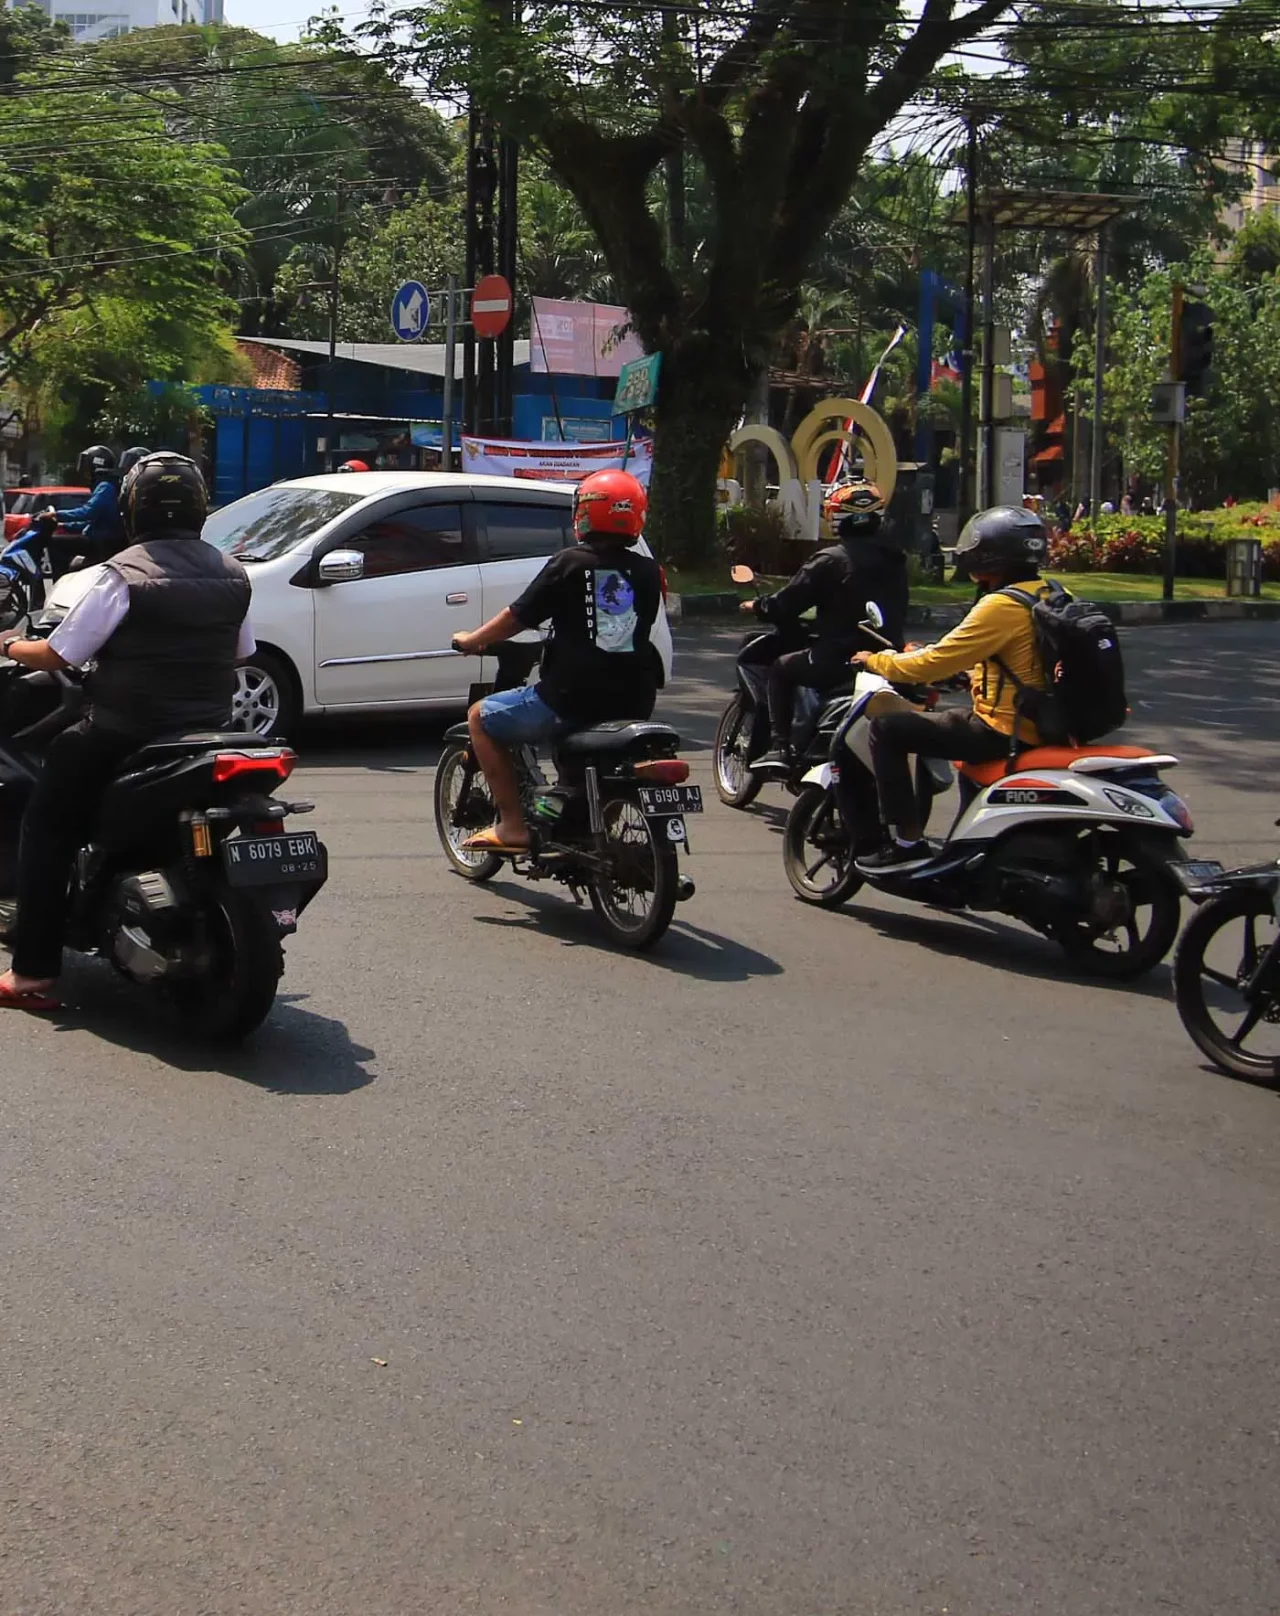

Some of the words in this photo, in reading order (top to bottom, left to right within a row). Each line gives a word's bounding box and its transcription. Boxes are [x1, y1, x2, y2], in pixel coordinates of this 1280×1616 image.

[642, 790, 651, 803] N
[654, 788, 680, 803] 6190
[686, 787, 700, 800] AJ
[230, 845, 241, 863] N
[248, 841, 283, 860] 6079
[288, 837, 315, 857] EBK
